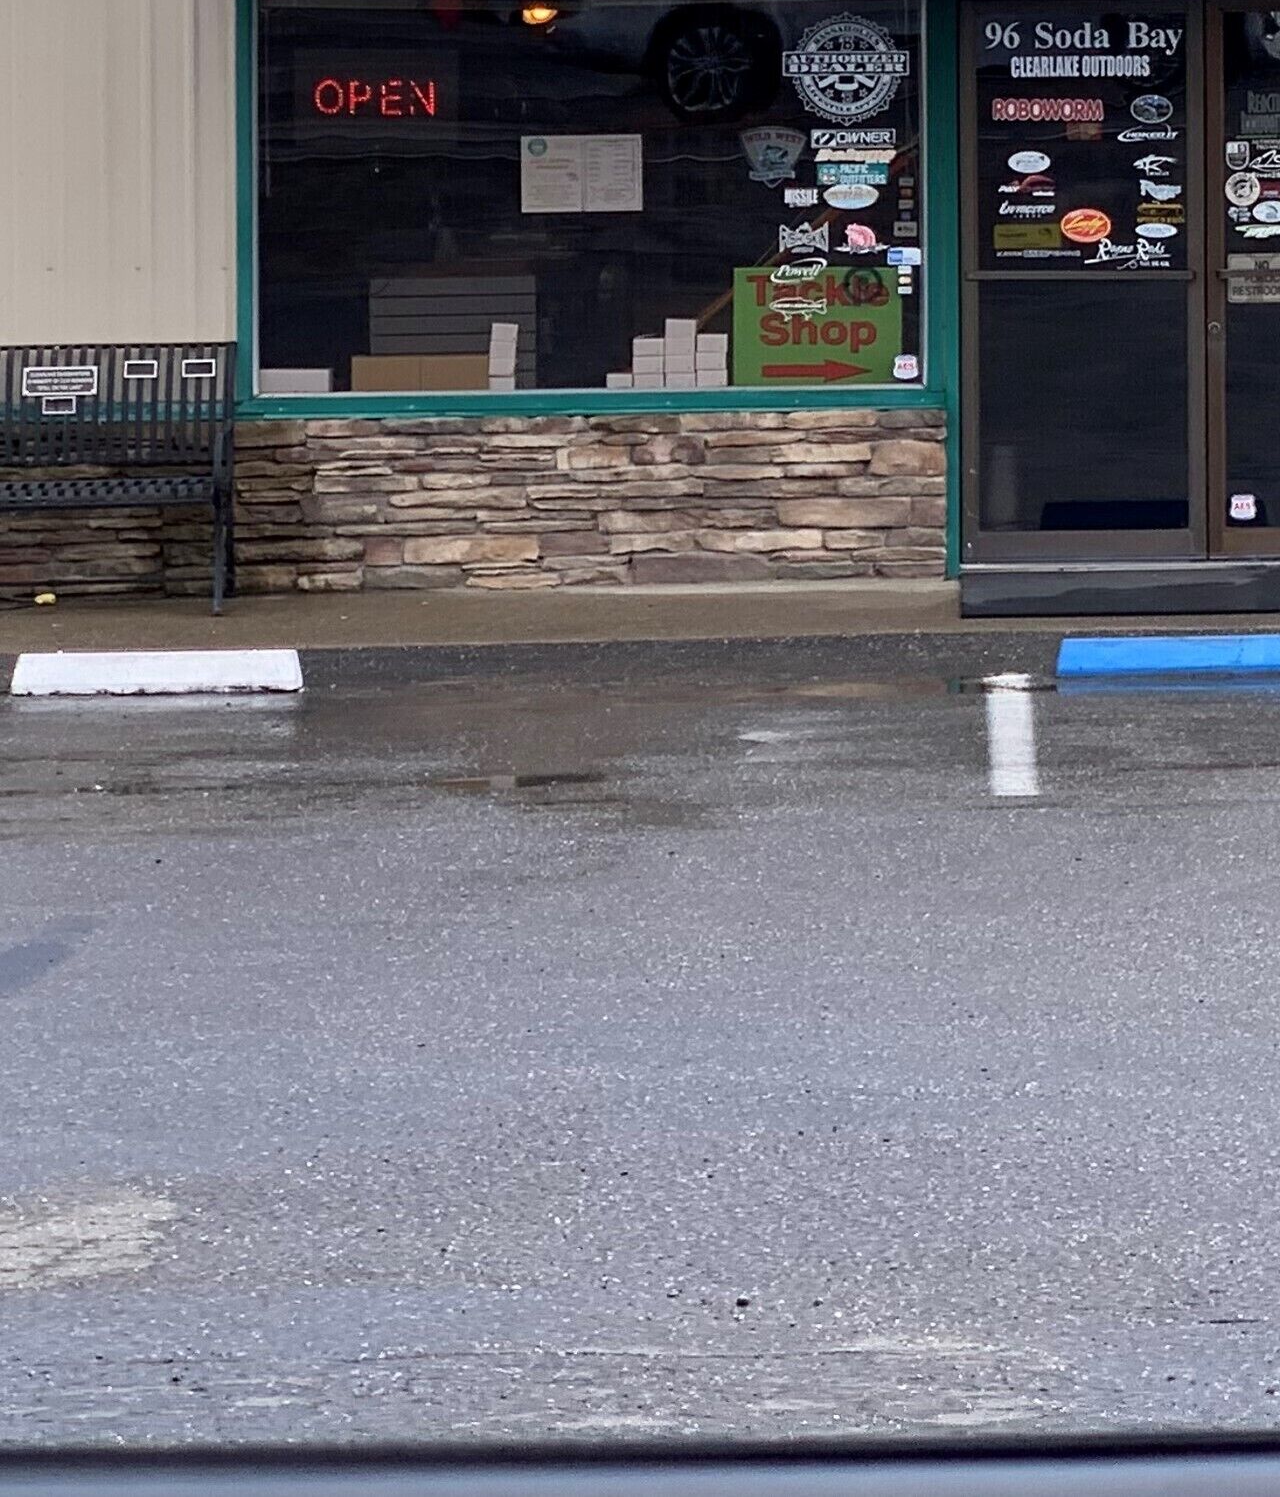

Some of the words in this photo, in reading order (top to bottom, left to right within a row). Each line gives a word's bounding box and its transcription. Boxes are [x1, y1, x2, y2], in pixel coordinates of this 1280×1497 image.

[985, 22, 1021, 49] 96
[1034, 22, 1110, 49] Soda
[1127, 22, 1183, 55] Bay
[787, 54, 906, 62] AUTHORIZED
[1010, 55, 1080, 78] CLEARLAKE
[1082, 55, 1150, 77] OUTDOORS
[788, 63, 905, 72] DEALER
[315, 79, 436, 116] OPEN
[992, 98, 1104, 121] ROBOWORM
[836, 132, 891, 143] OWNER
[839, 175, 887, 185] OUTFITTERS
[778, 263, 821, 277] Powell
[1254, 261, 1270, 270] NO
[746, 275, 890, 307] Tackle
[759, 313, 877, 353] Shop
